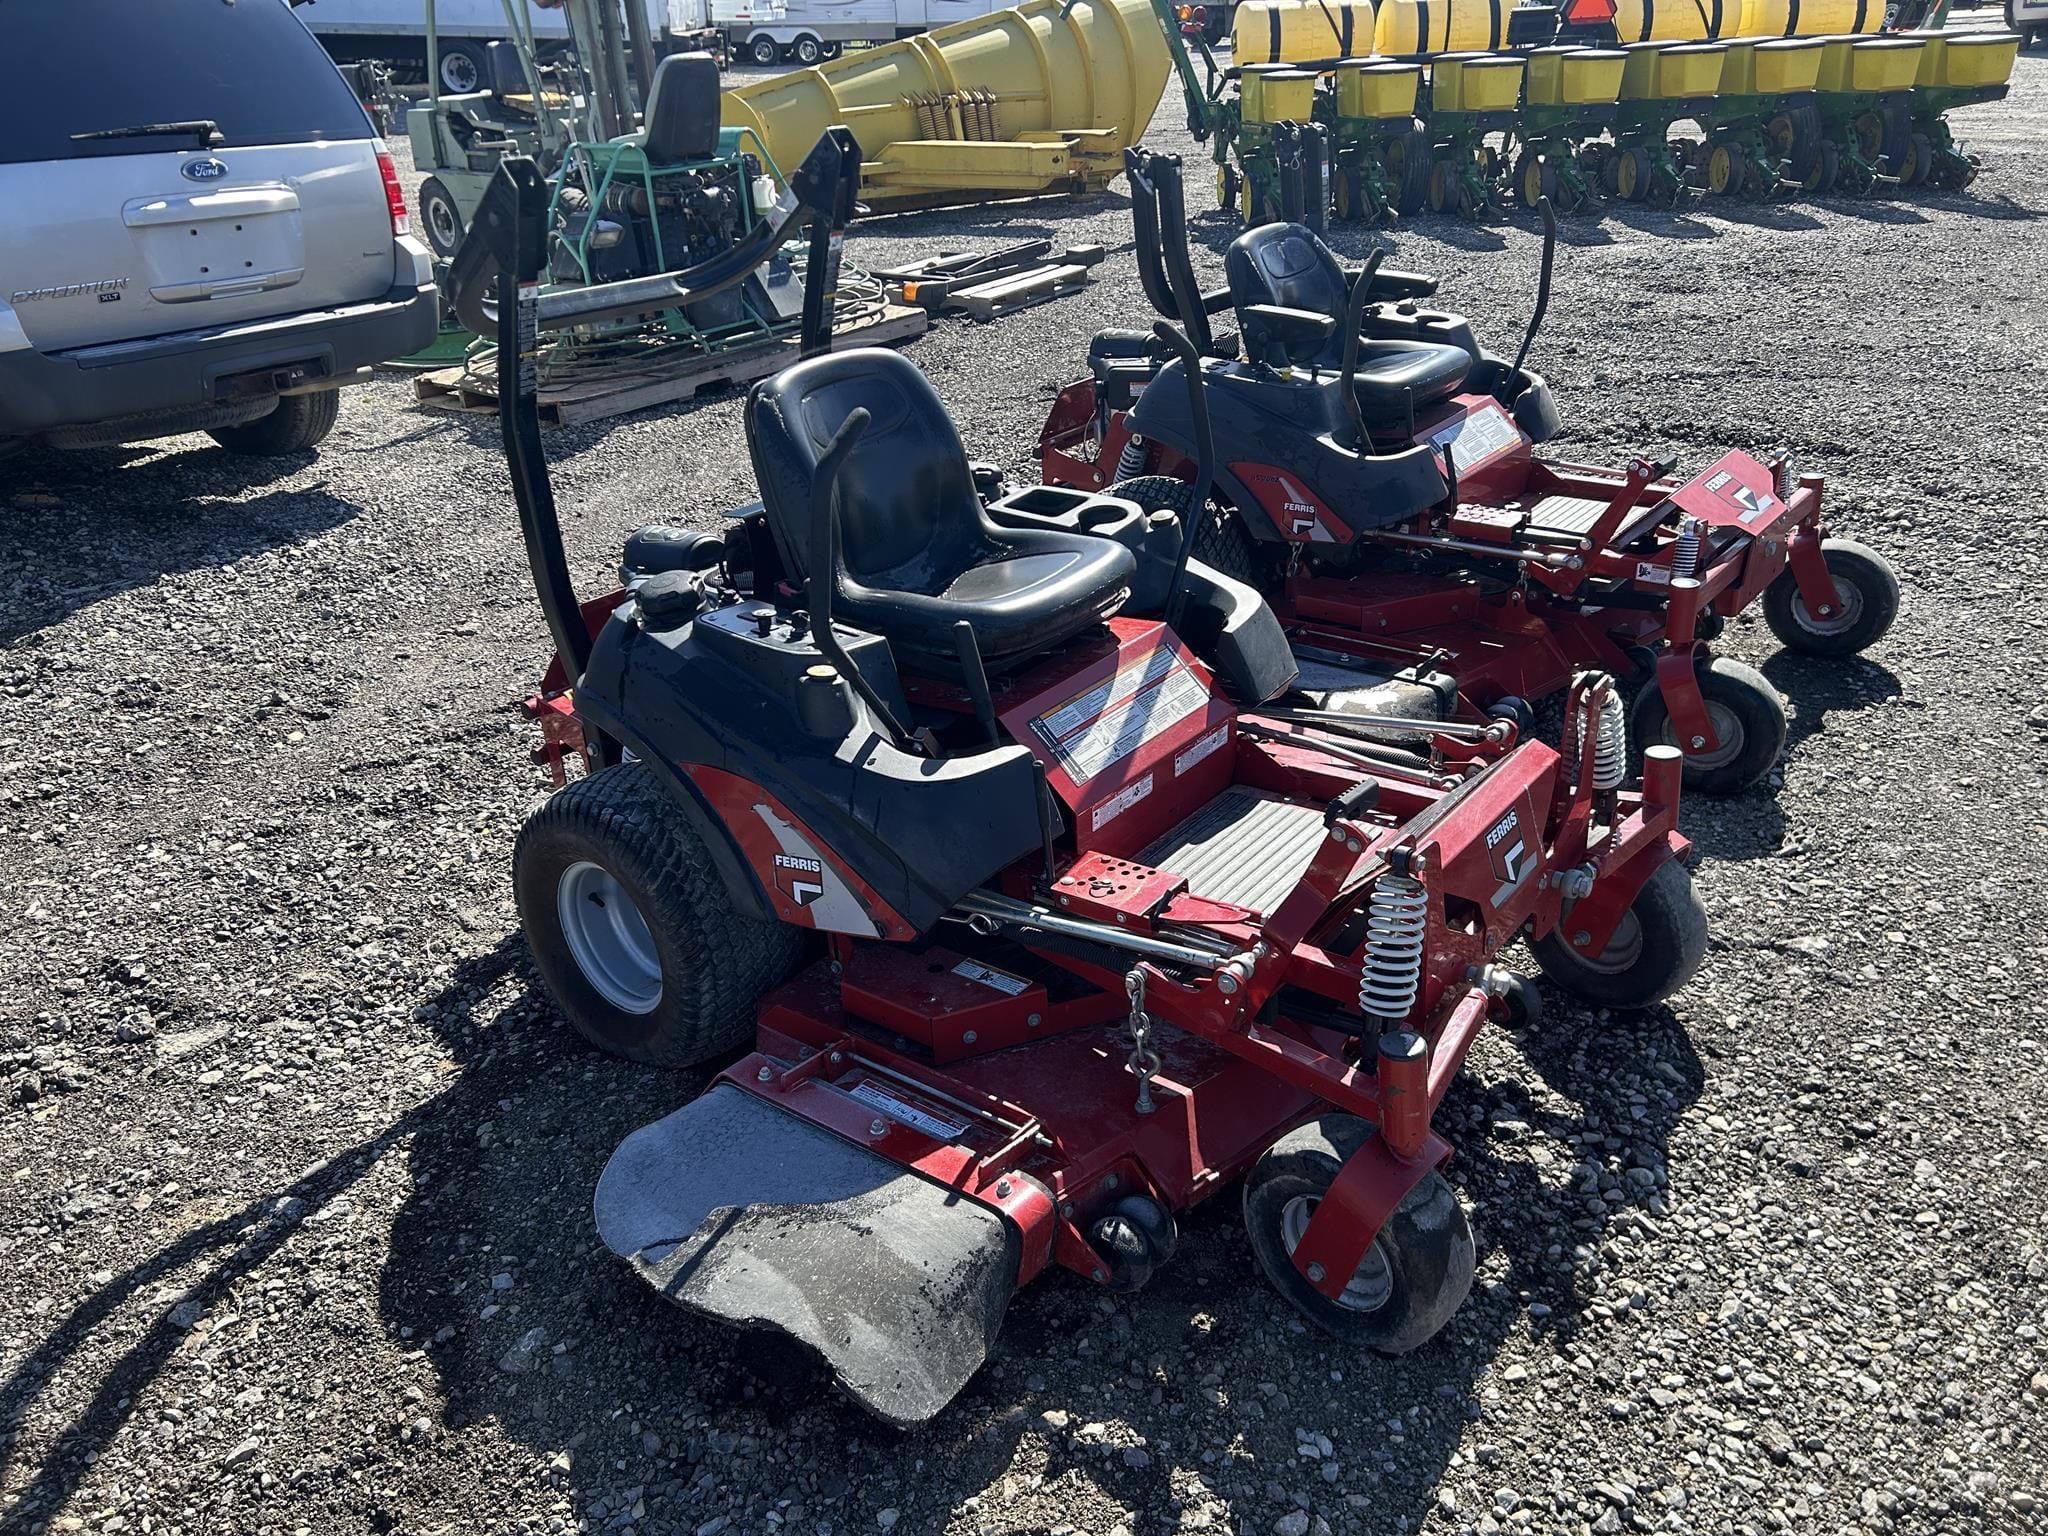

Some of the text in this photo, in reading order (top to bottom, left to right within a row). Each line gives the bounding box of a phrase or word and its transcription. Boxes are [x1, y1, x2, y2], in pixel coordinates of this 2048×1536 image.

[195, 163, 218, 177] Ford
[10, 277, 130, 304] EXPEDITION
[100, 292, 119, 301] XLT
[1284, 502, 1315, 513] FERRIS
[1486, 811, 1517, 849] FERRIS
[775, 854, 820, 872] FERRIS
